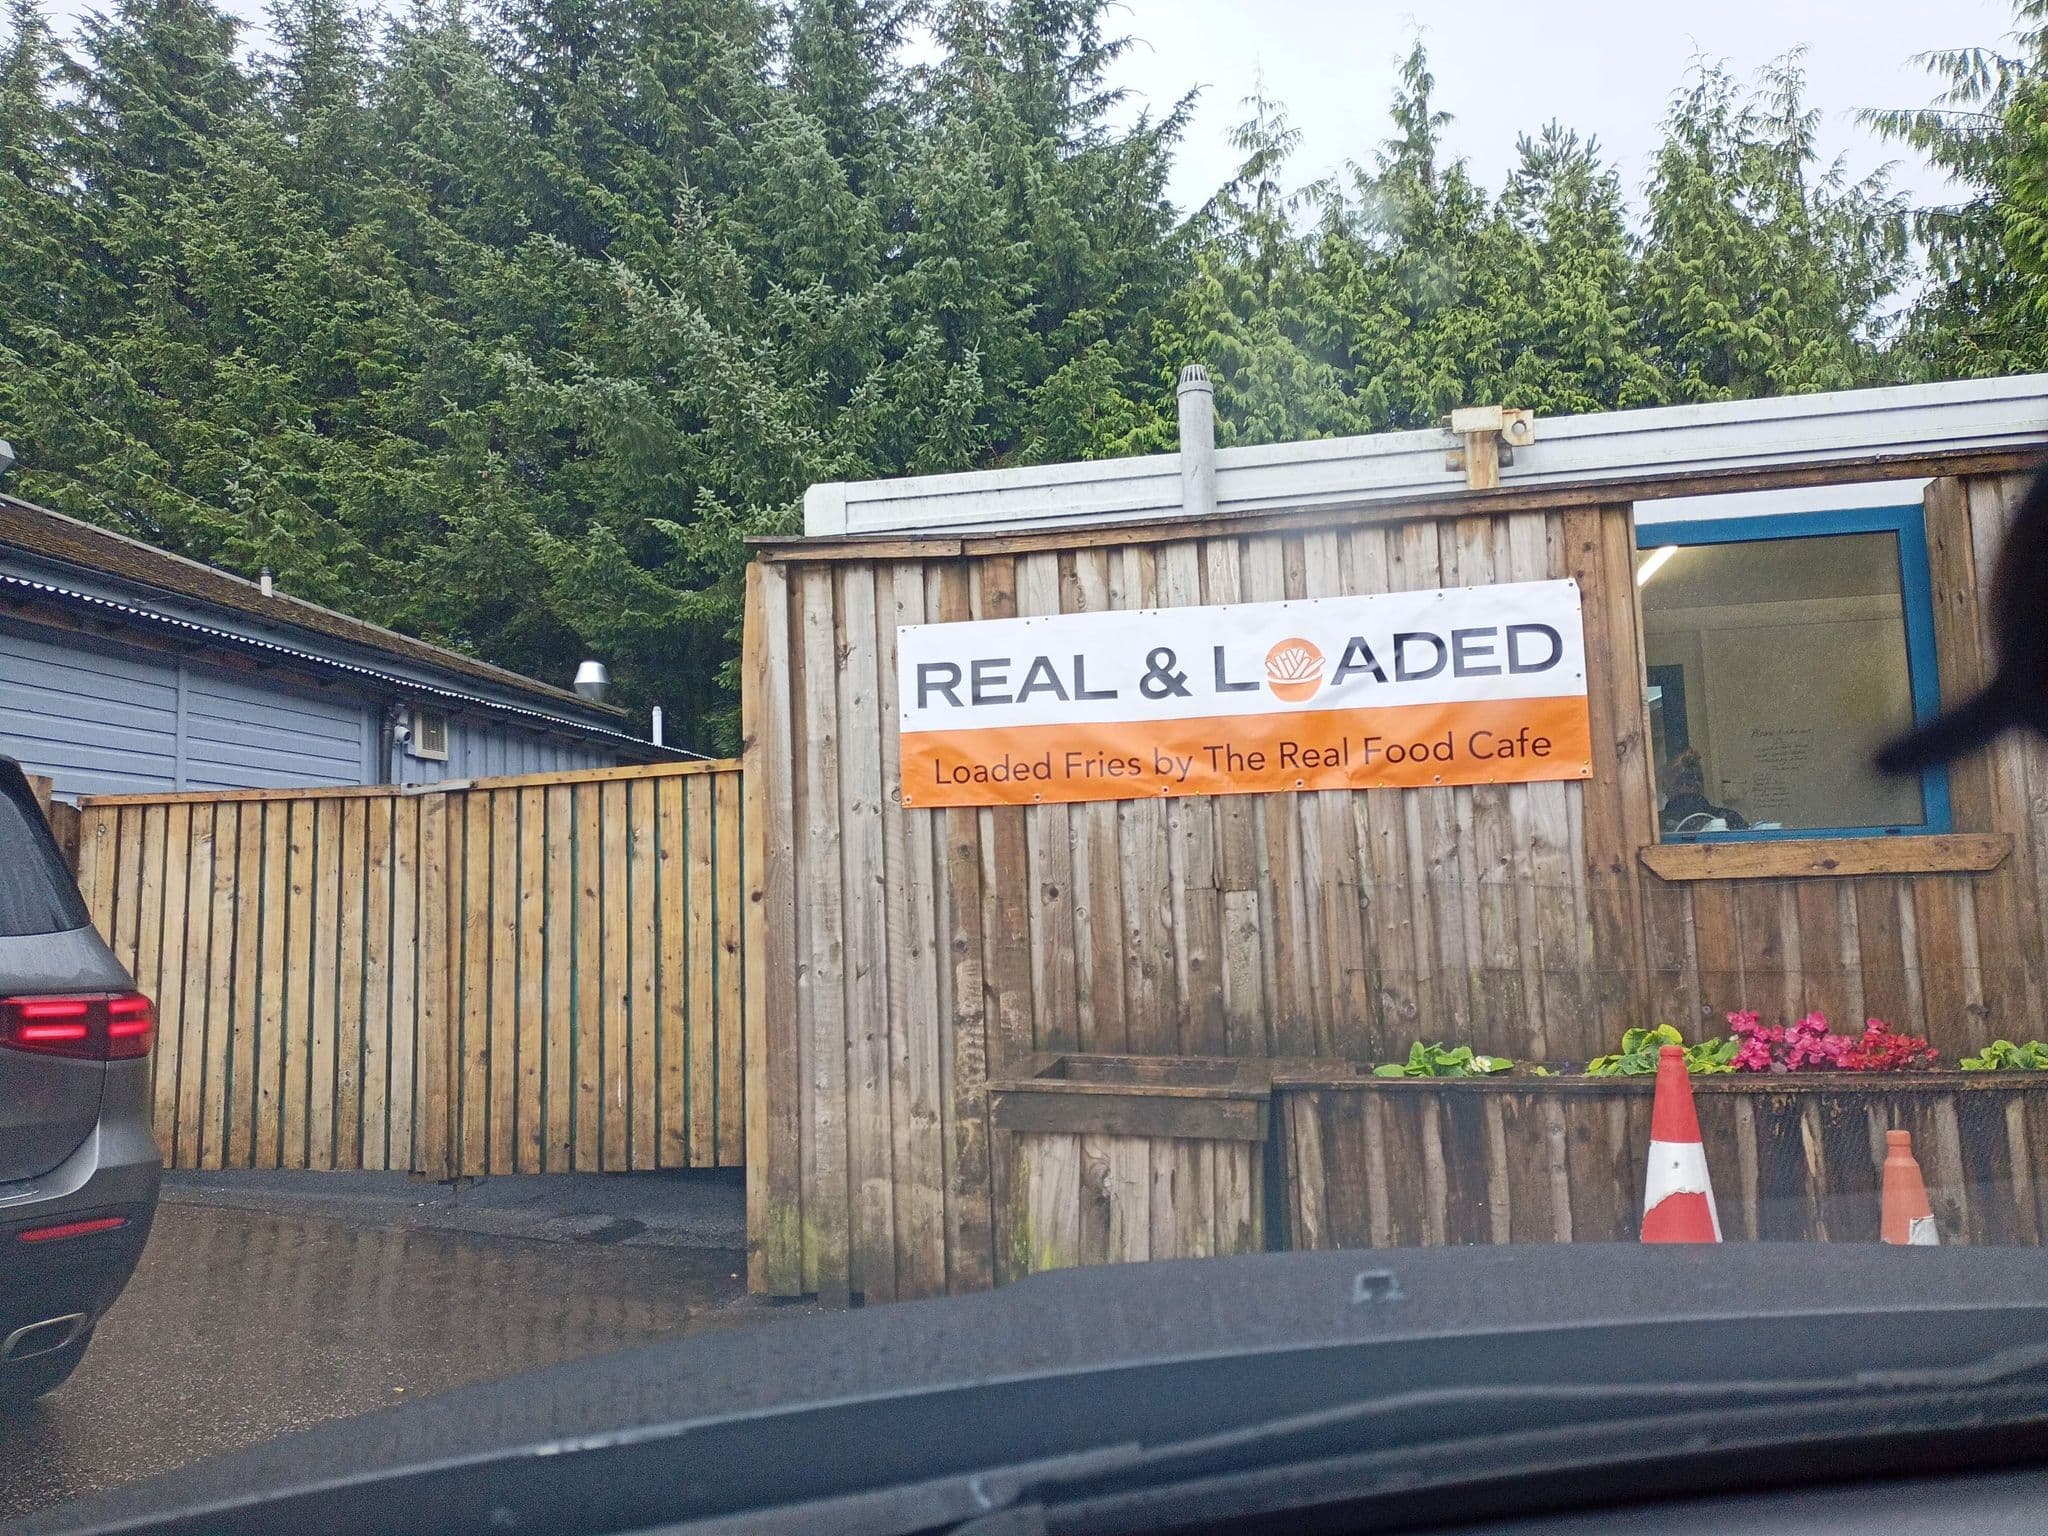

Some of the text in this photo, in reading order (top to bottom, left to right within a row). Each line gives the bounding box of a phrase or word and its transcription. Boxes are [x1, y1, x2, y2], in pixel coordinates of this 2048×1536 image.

[917, 623, 1563, 709] REAL & LOADED
[935, 727, 1553, 785] Loaded Fries by The Real Food Cafe
